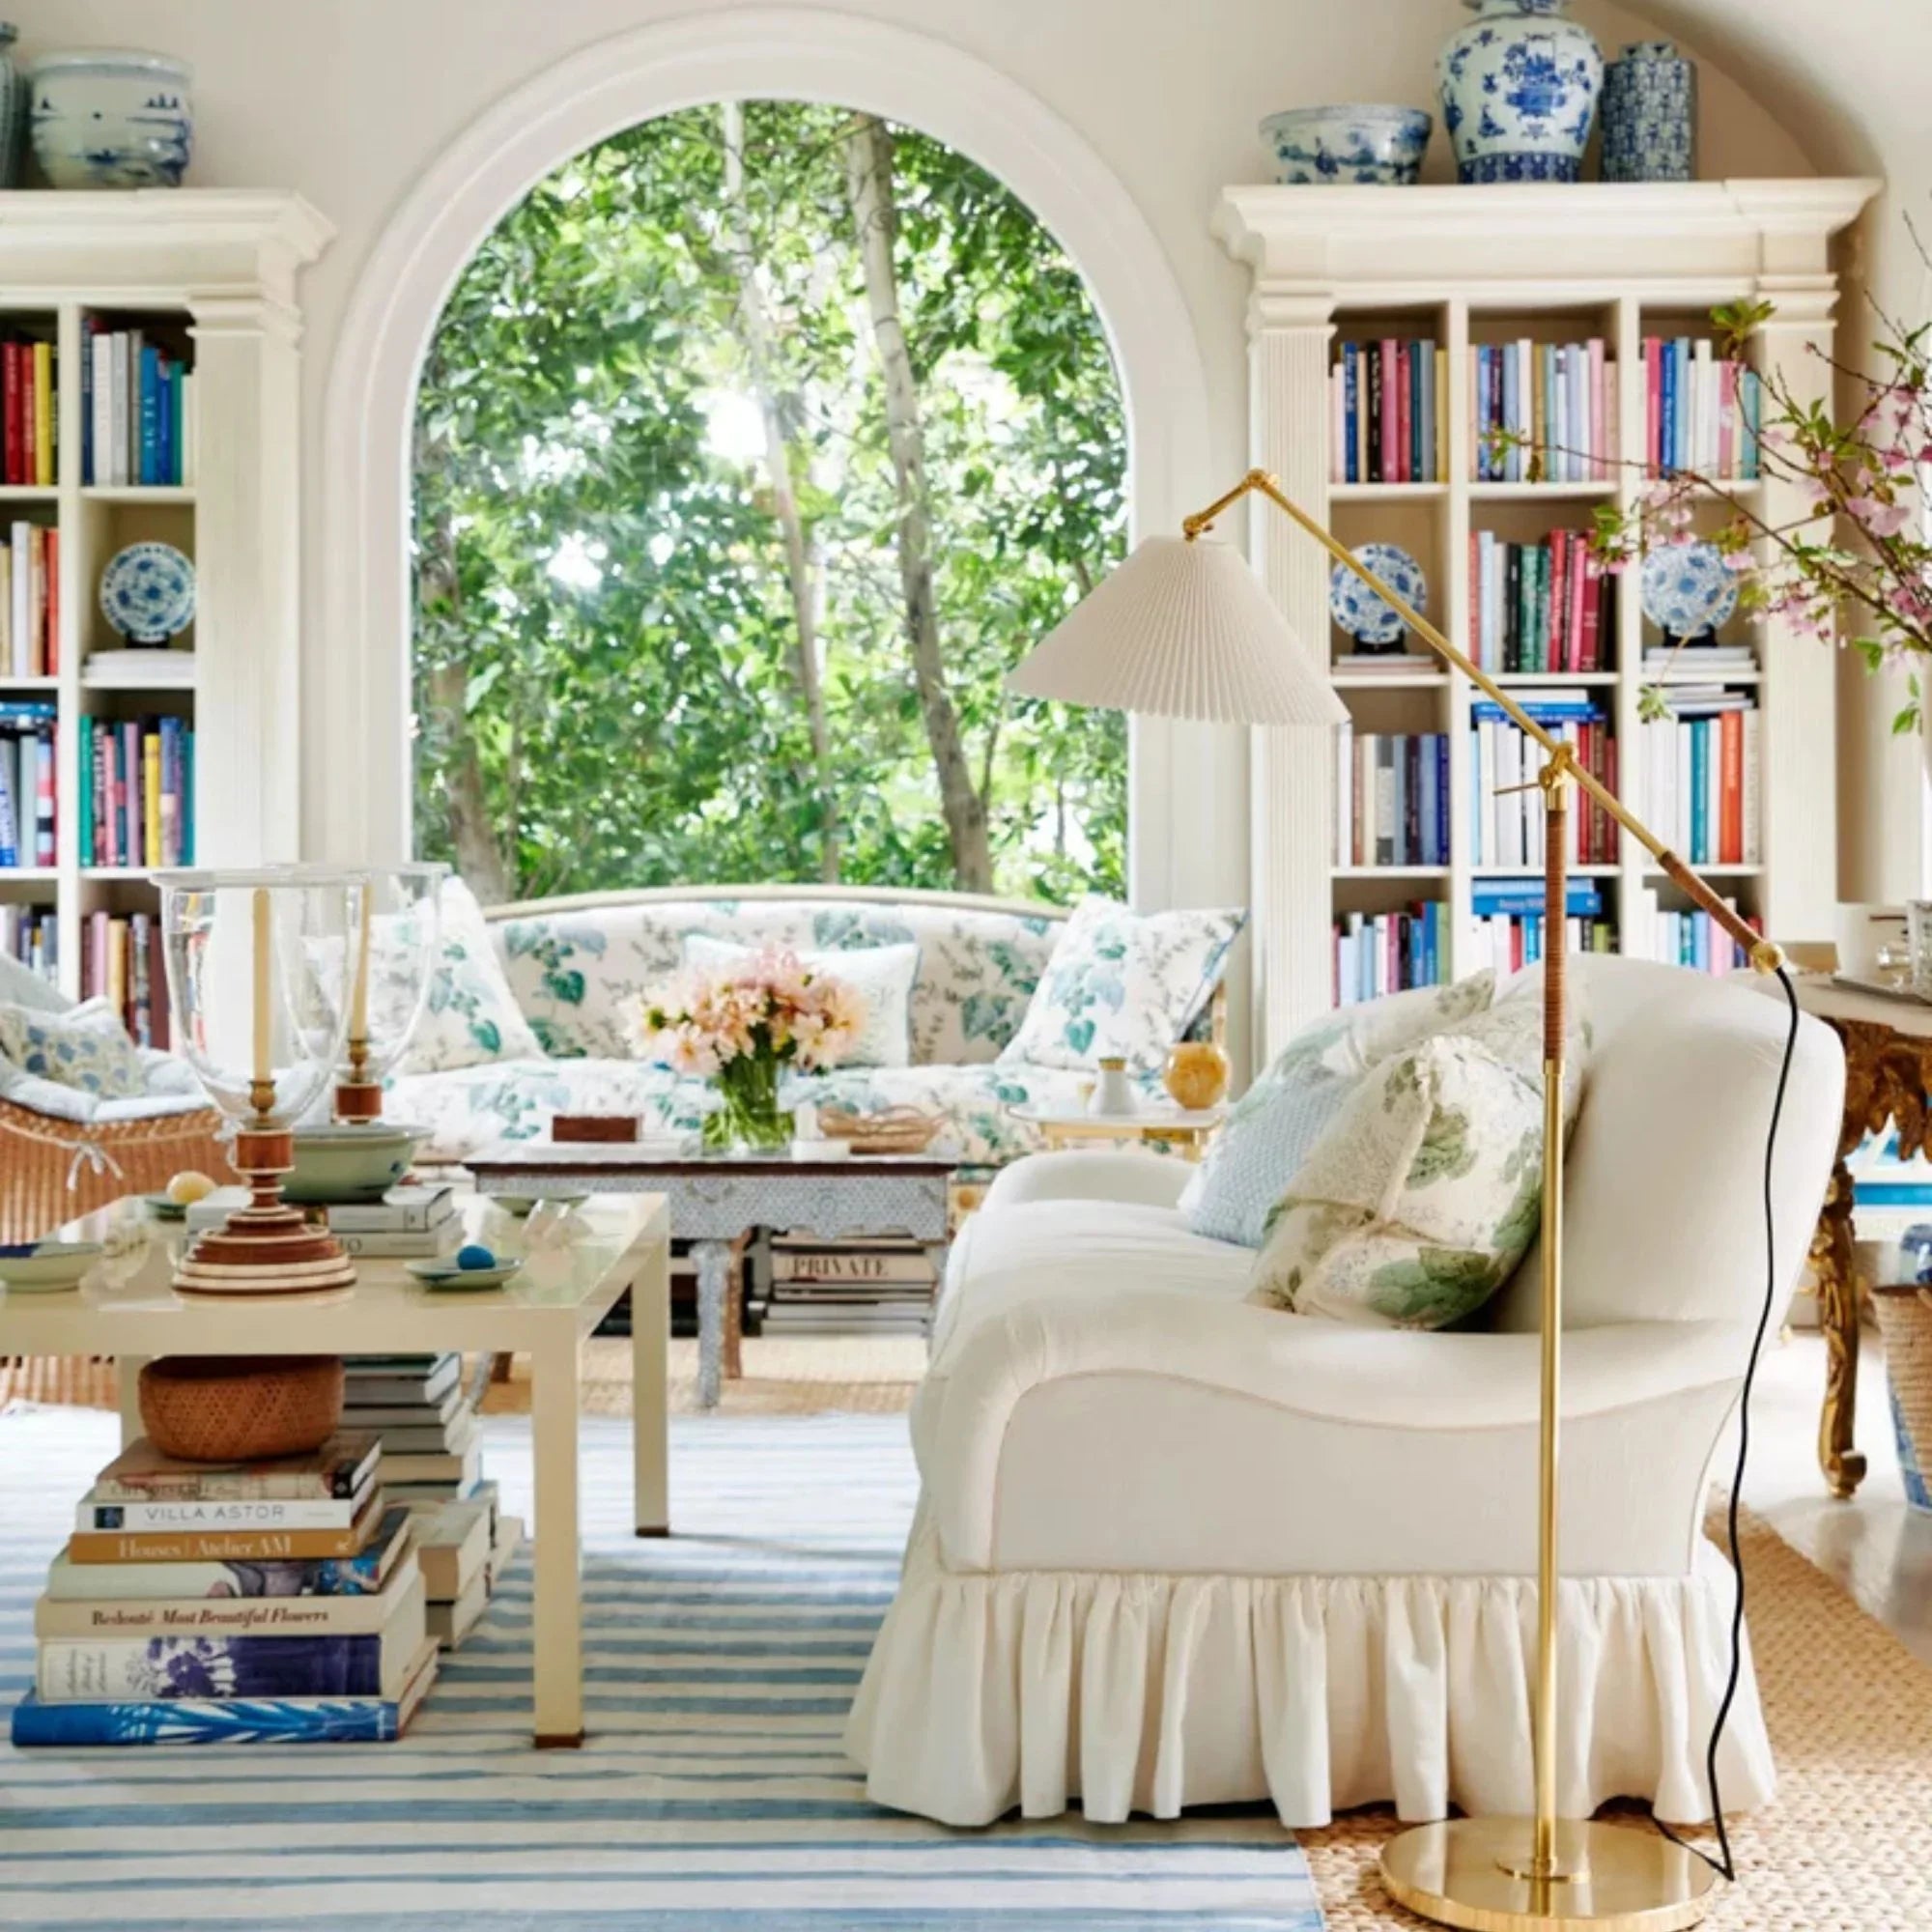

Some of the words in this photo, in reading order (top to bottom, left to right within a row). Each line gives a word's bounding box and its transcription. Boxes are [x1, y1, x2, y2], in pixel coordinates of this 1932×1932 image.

[792, 1257, 889, 1276] PRIVATE
[146, 1507, 206, 1521] VILLA
[214, 1504, 284, 1520] ASTOR
[119, 1538, 181, 1558] Houses
[163, 1608, 194, 1625] Most
[199, 1607, 268, 1629] Beautiful
[270, 1606, 328, 1624] Flowers
